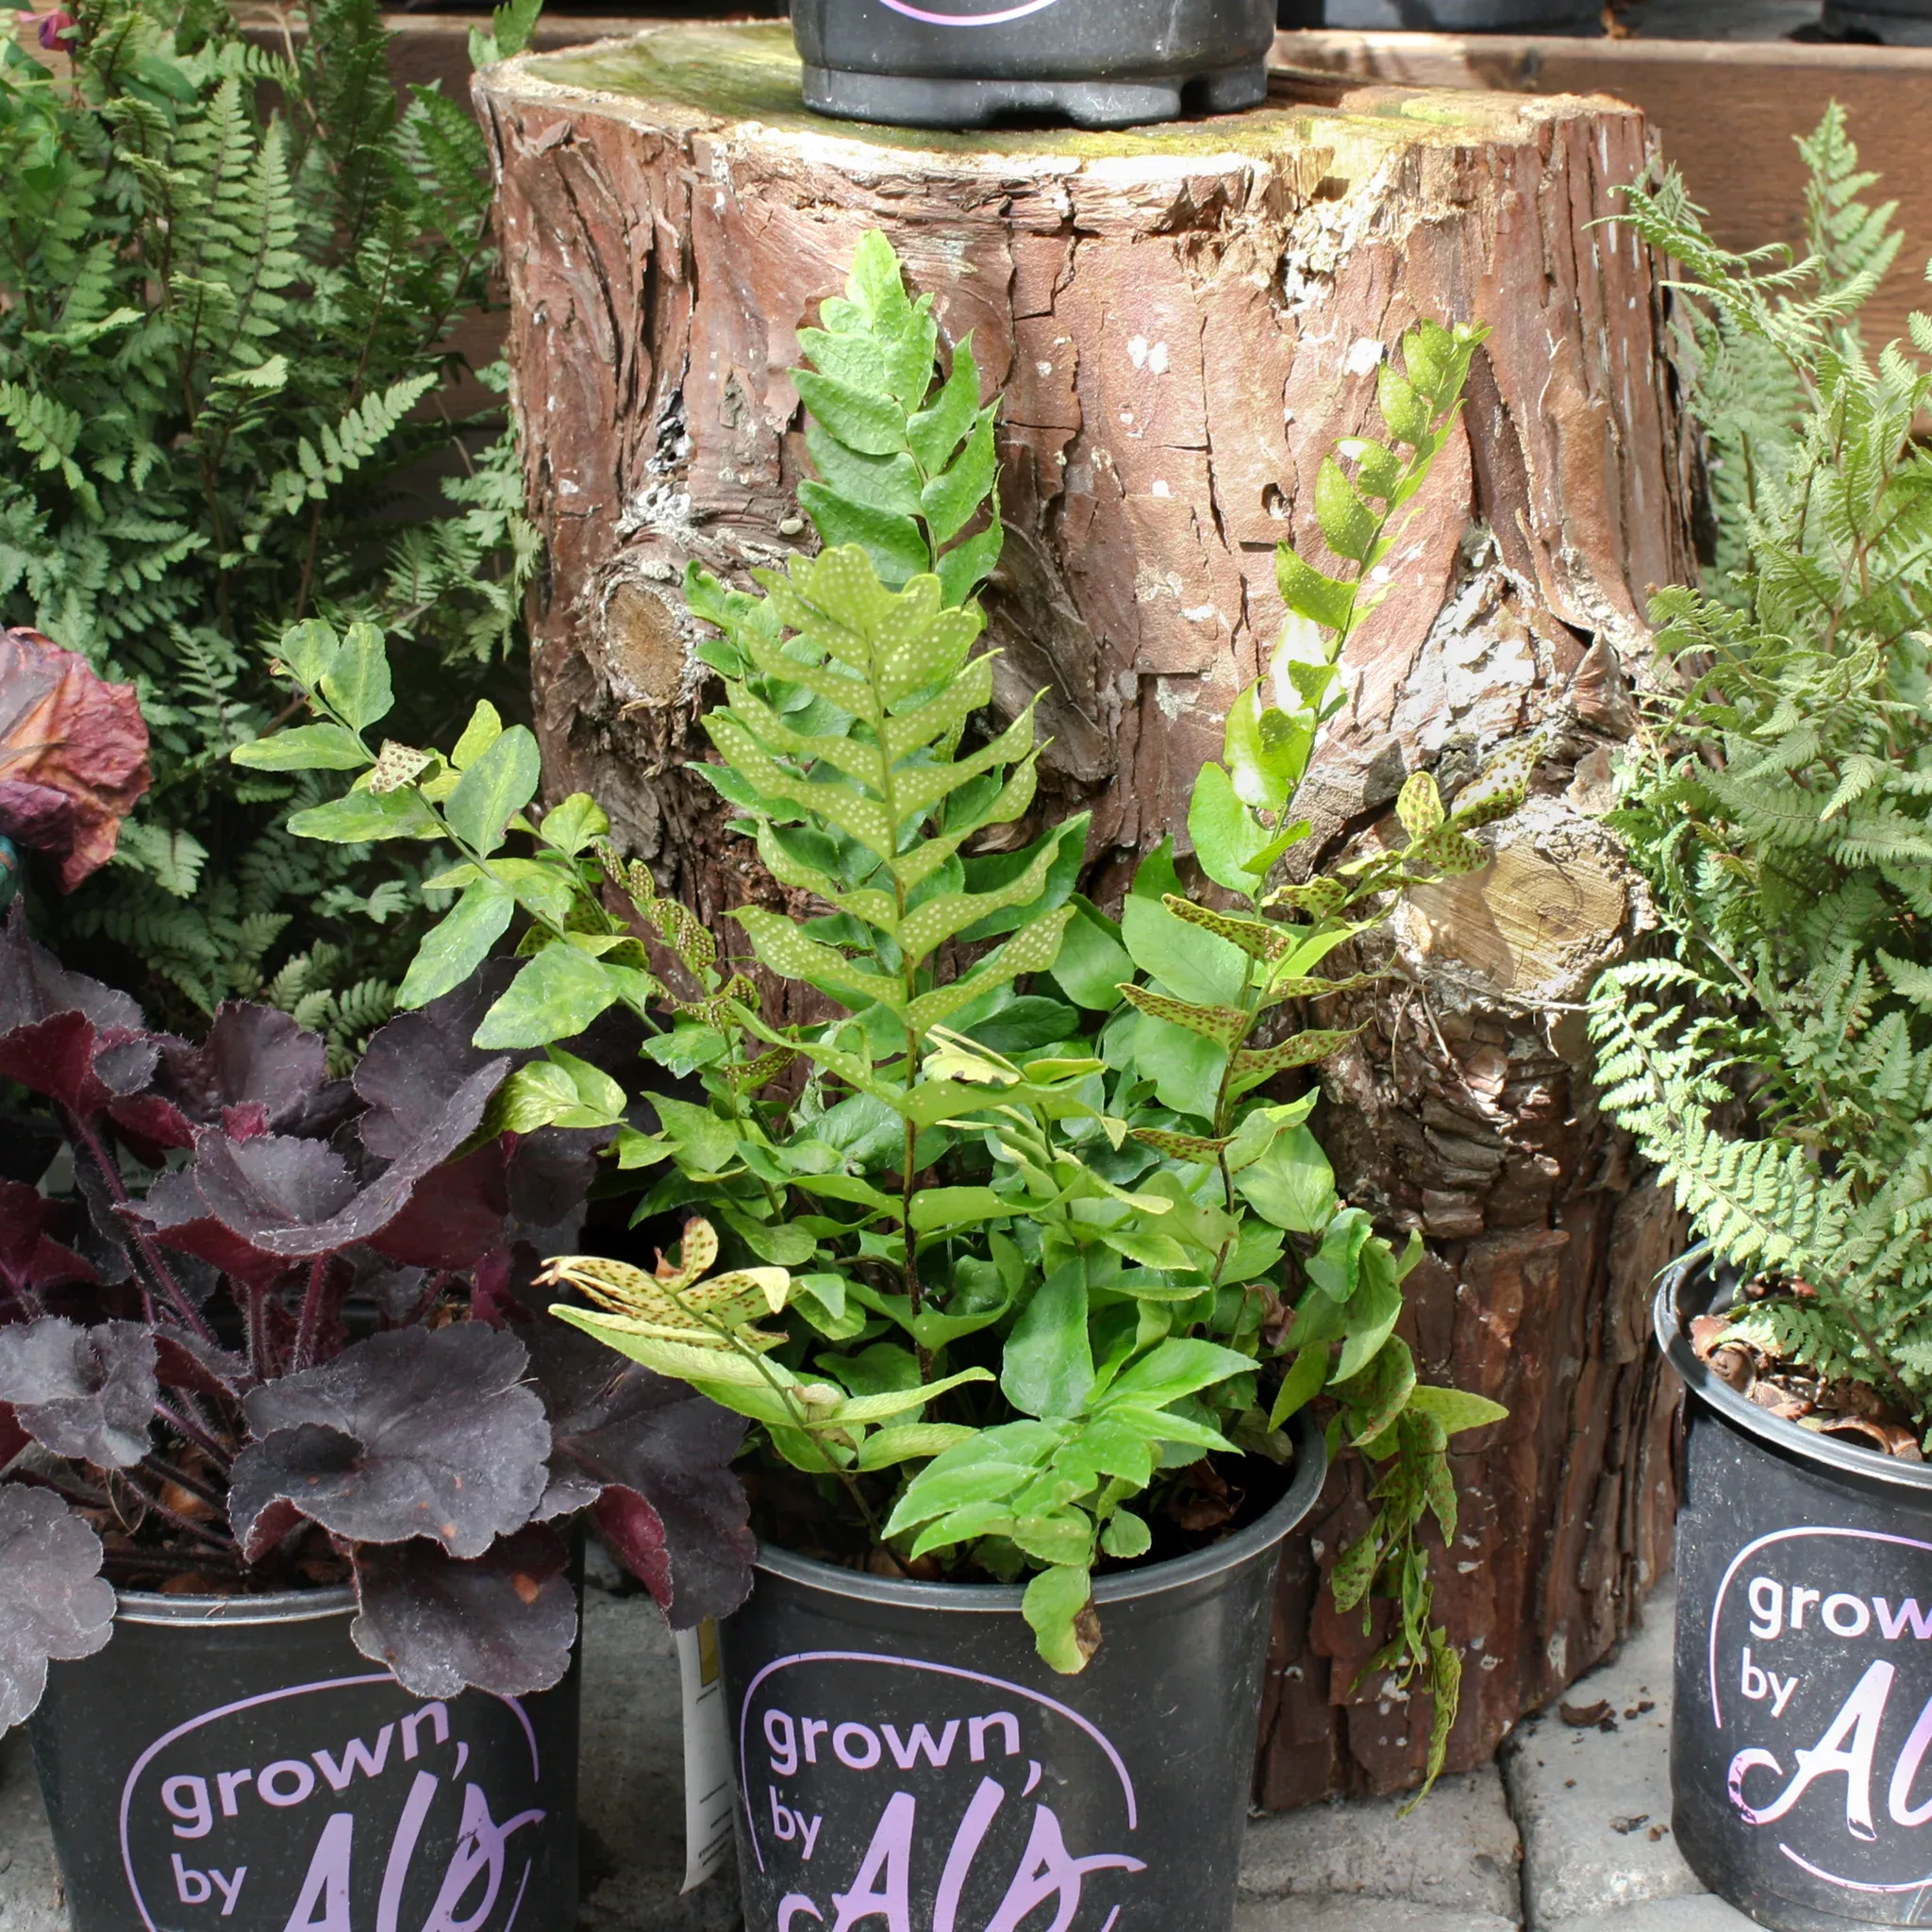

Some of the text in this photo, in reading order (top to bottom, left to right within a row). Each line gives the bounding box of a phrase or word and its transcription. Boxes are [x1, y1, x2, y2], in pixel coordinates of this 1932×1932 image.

[1740, 1646, 1798, 1718] by
[160, 1700, 449, 1839] grown
[762, 1708, 1022, 1776] grown
[769, 1785, 823, 1860] by
[170, 1853, 248, 1916] by
